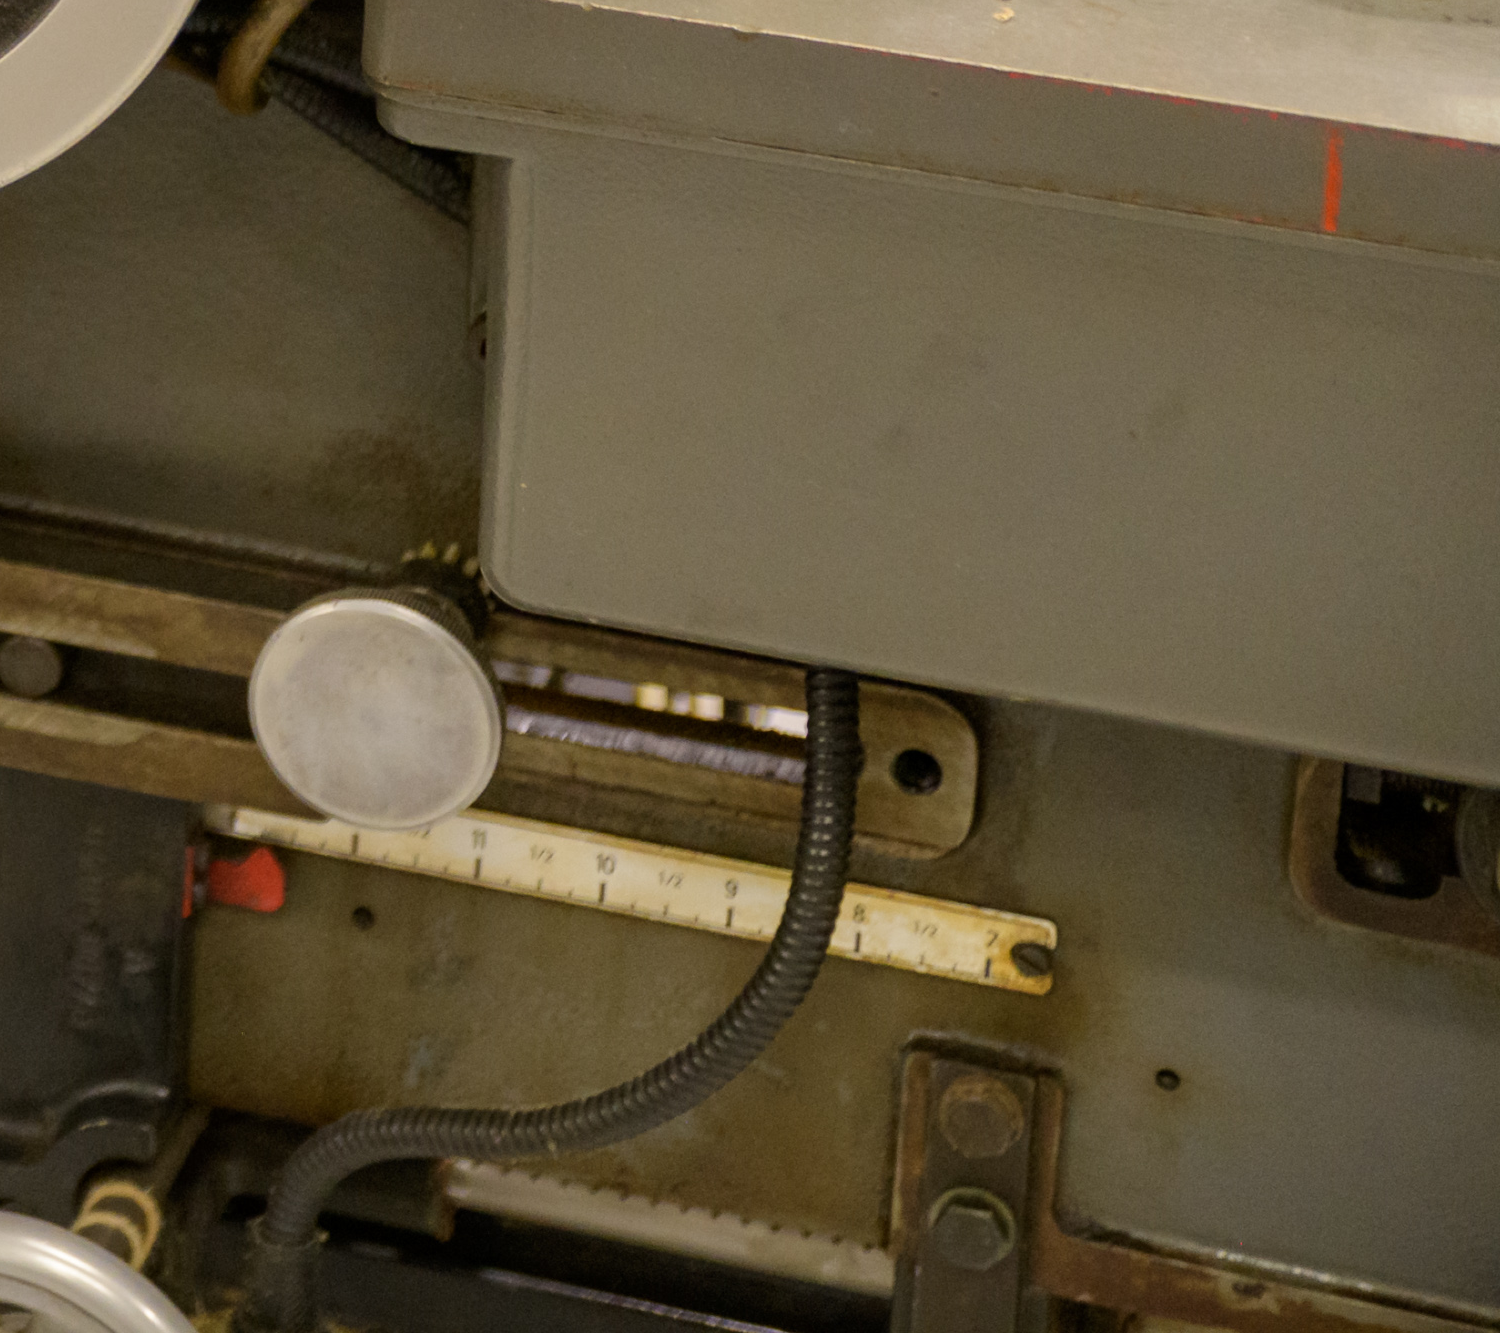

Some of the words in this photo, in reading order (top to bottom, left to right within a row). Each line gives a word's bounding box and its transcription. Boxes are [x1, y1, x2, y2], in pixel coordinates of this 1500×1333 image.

[596, 852, 617, 876] 10
[725, 878, 740, 899] 9
[852, 902, 868, 923] 8
